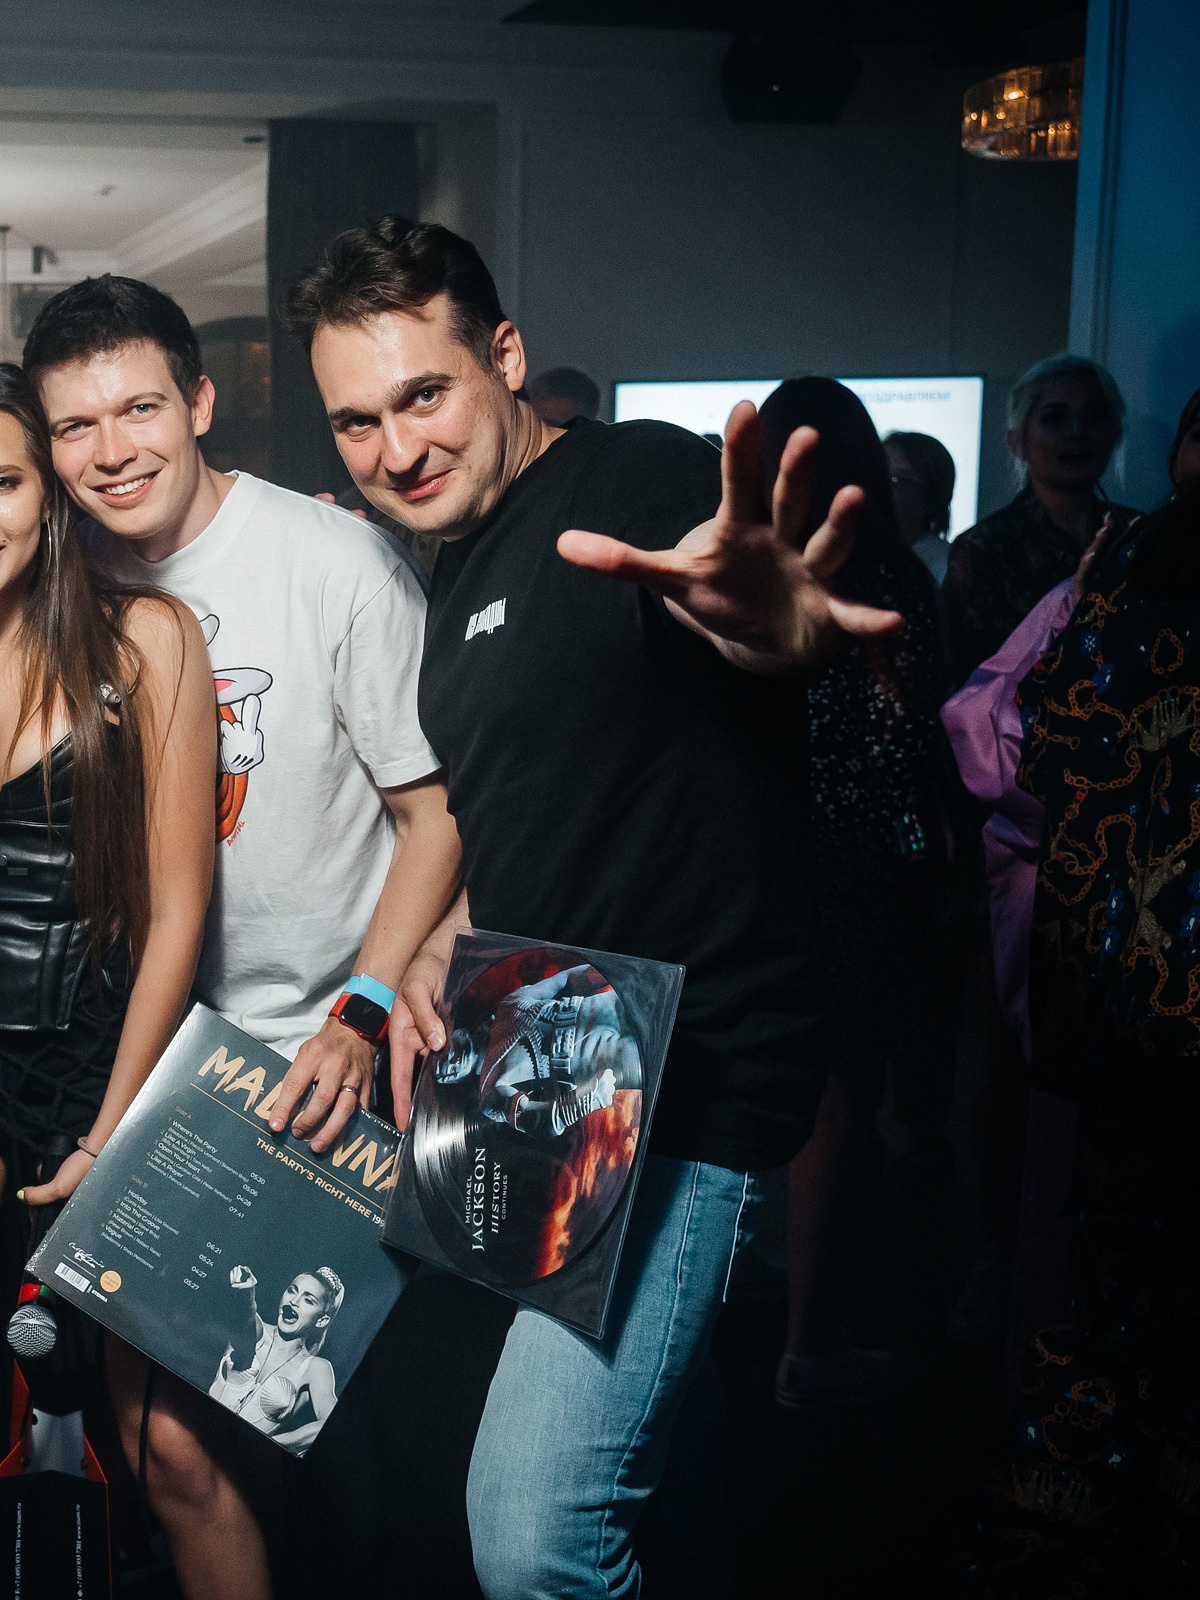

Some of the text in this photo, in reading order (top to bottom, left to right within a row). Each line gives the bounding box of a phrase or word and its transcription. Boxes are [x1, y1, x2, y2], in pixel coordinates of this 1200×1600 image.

[165, 1132, 176, 1142] Like
[181, 1142, 196, 1156] Virgin
[194, 1134, 204, 1144] The
[203, 1141, 218, 1154] Party
[151, 1154, 162, 1164] Like
[167, 1165, 184, 1178] Prayer
[158, 1143, 173, 1155] Open
[174, 1152, 185, 1163] Your
[186, 1161, 200, 1173] Heart
[257, 1138, 276, 1155] THE
[276, 1152, 314, 1180] PARTY'S
[315, 1177, 346, 1199] RIGHT
[345, 1197, 372, 1218] HERE
[128, 1190, 148, 1206] Holiday
[471, 1146, 487, 1251] JACKSON
[490, 1161, 501, 1235] HISTORY
[113, 1214, 134, 1229] Material
[134, 1228, 144, 1236] Girl
[120, 1202, 132, 1211] Into
[132, 1208, 142, 1218] The
[142, 1216, 160, 1230] Groove
[106, 1225, 122, 1239] Vogue
